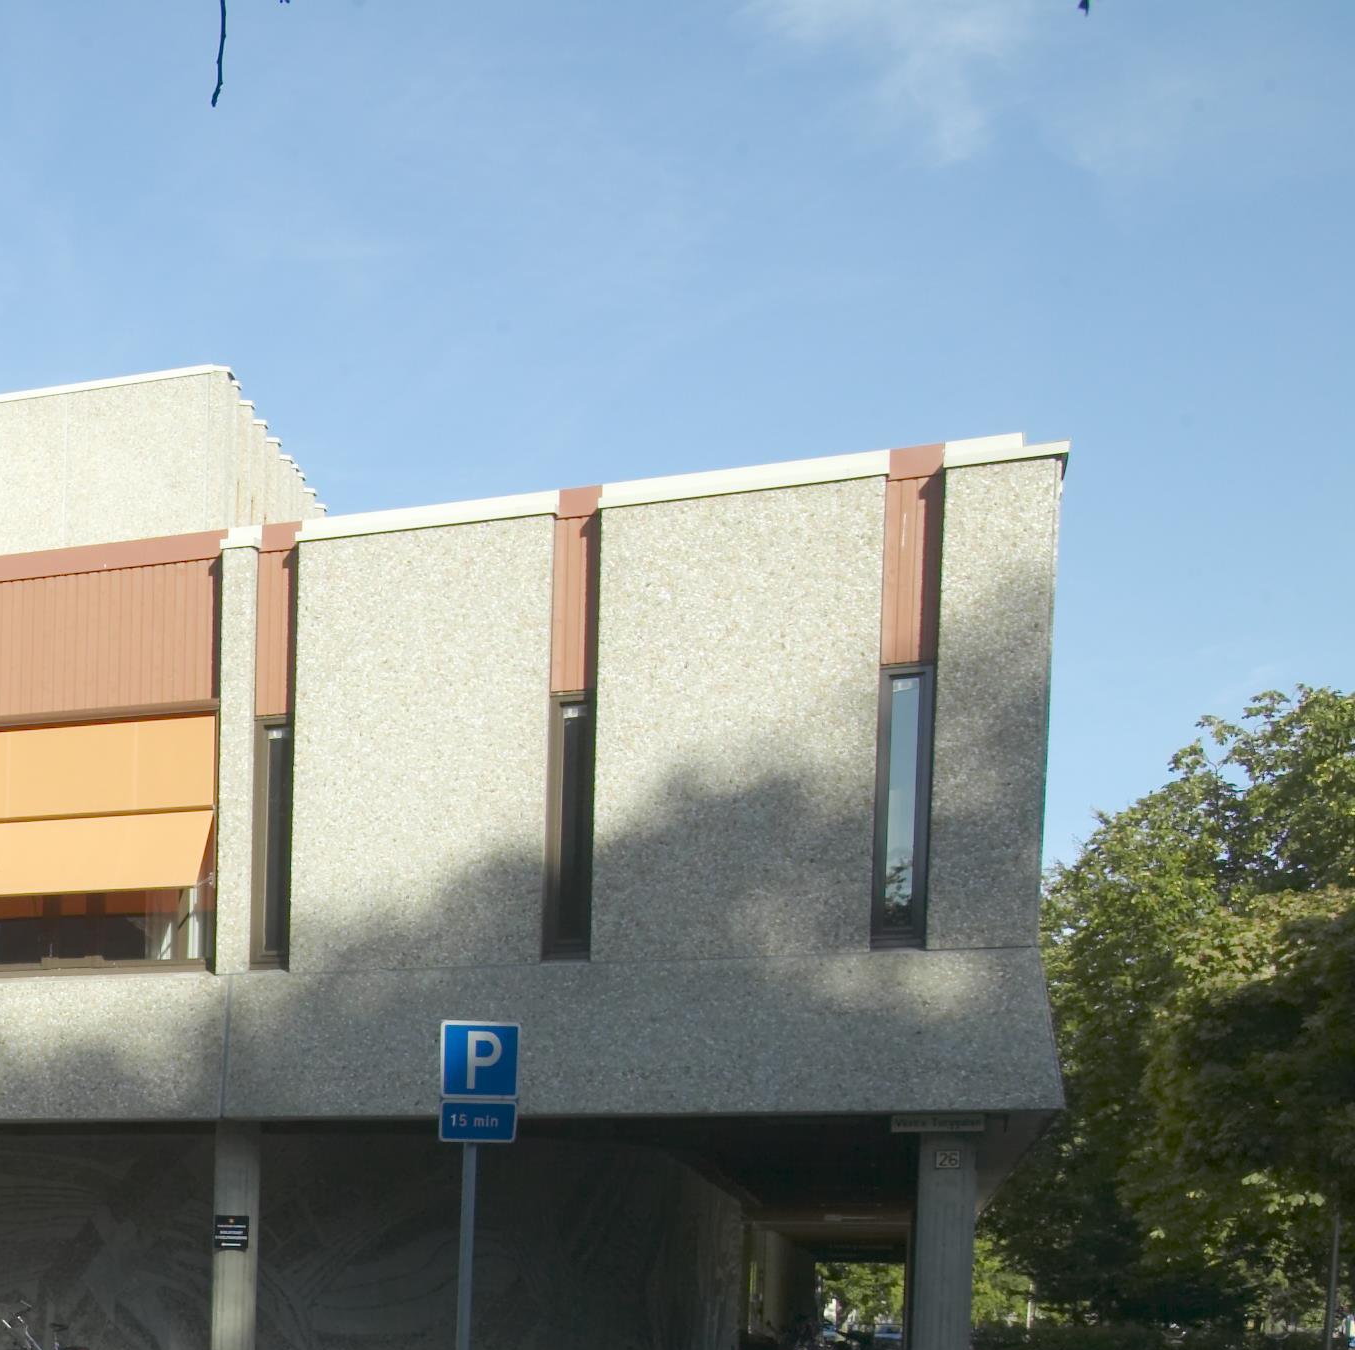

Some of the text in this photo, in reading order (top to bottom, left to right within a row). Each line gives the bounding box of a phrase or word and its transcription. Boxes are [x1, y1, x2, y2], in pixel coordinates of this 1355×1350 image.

[466, 1030, 503, 1090] P
[450, 1113, 499, 1128] 15 min
[938, 1151, 958, 1167] 26
